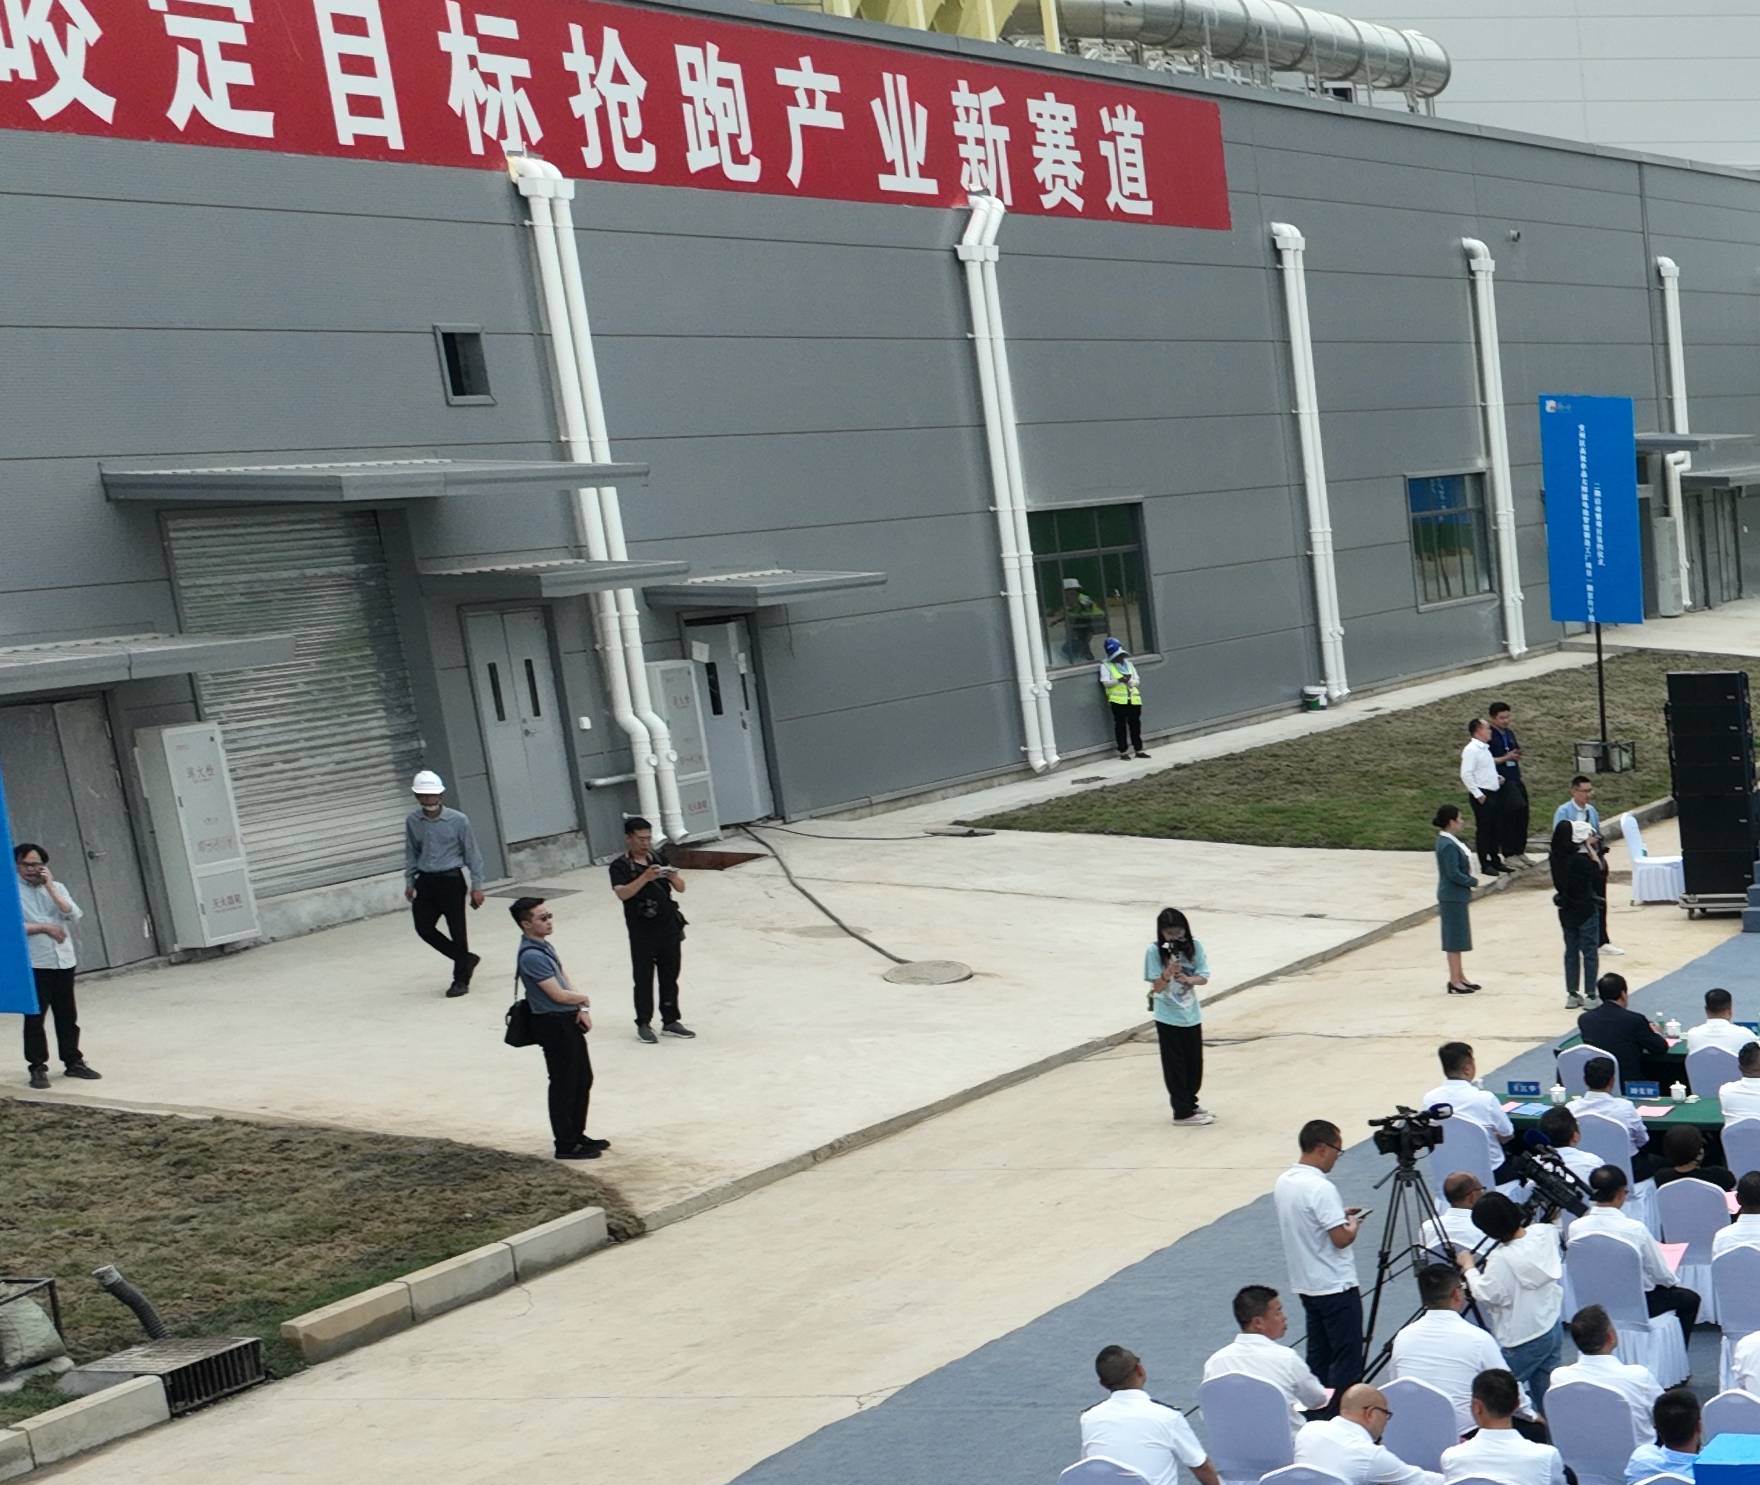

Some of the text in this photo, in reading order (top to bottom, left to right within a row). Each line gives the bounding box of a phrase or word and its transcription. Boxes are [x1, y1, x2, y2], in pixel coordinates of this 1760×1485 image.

[0, 0, 1155, 216] 咬定目标抢跑产业新赛道
